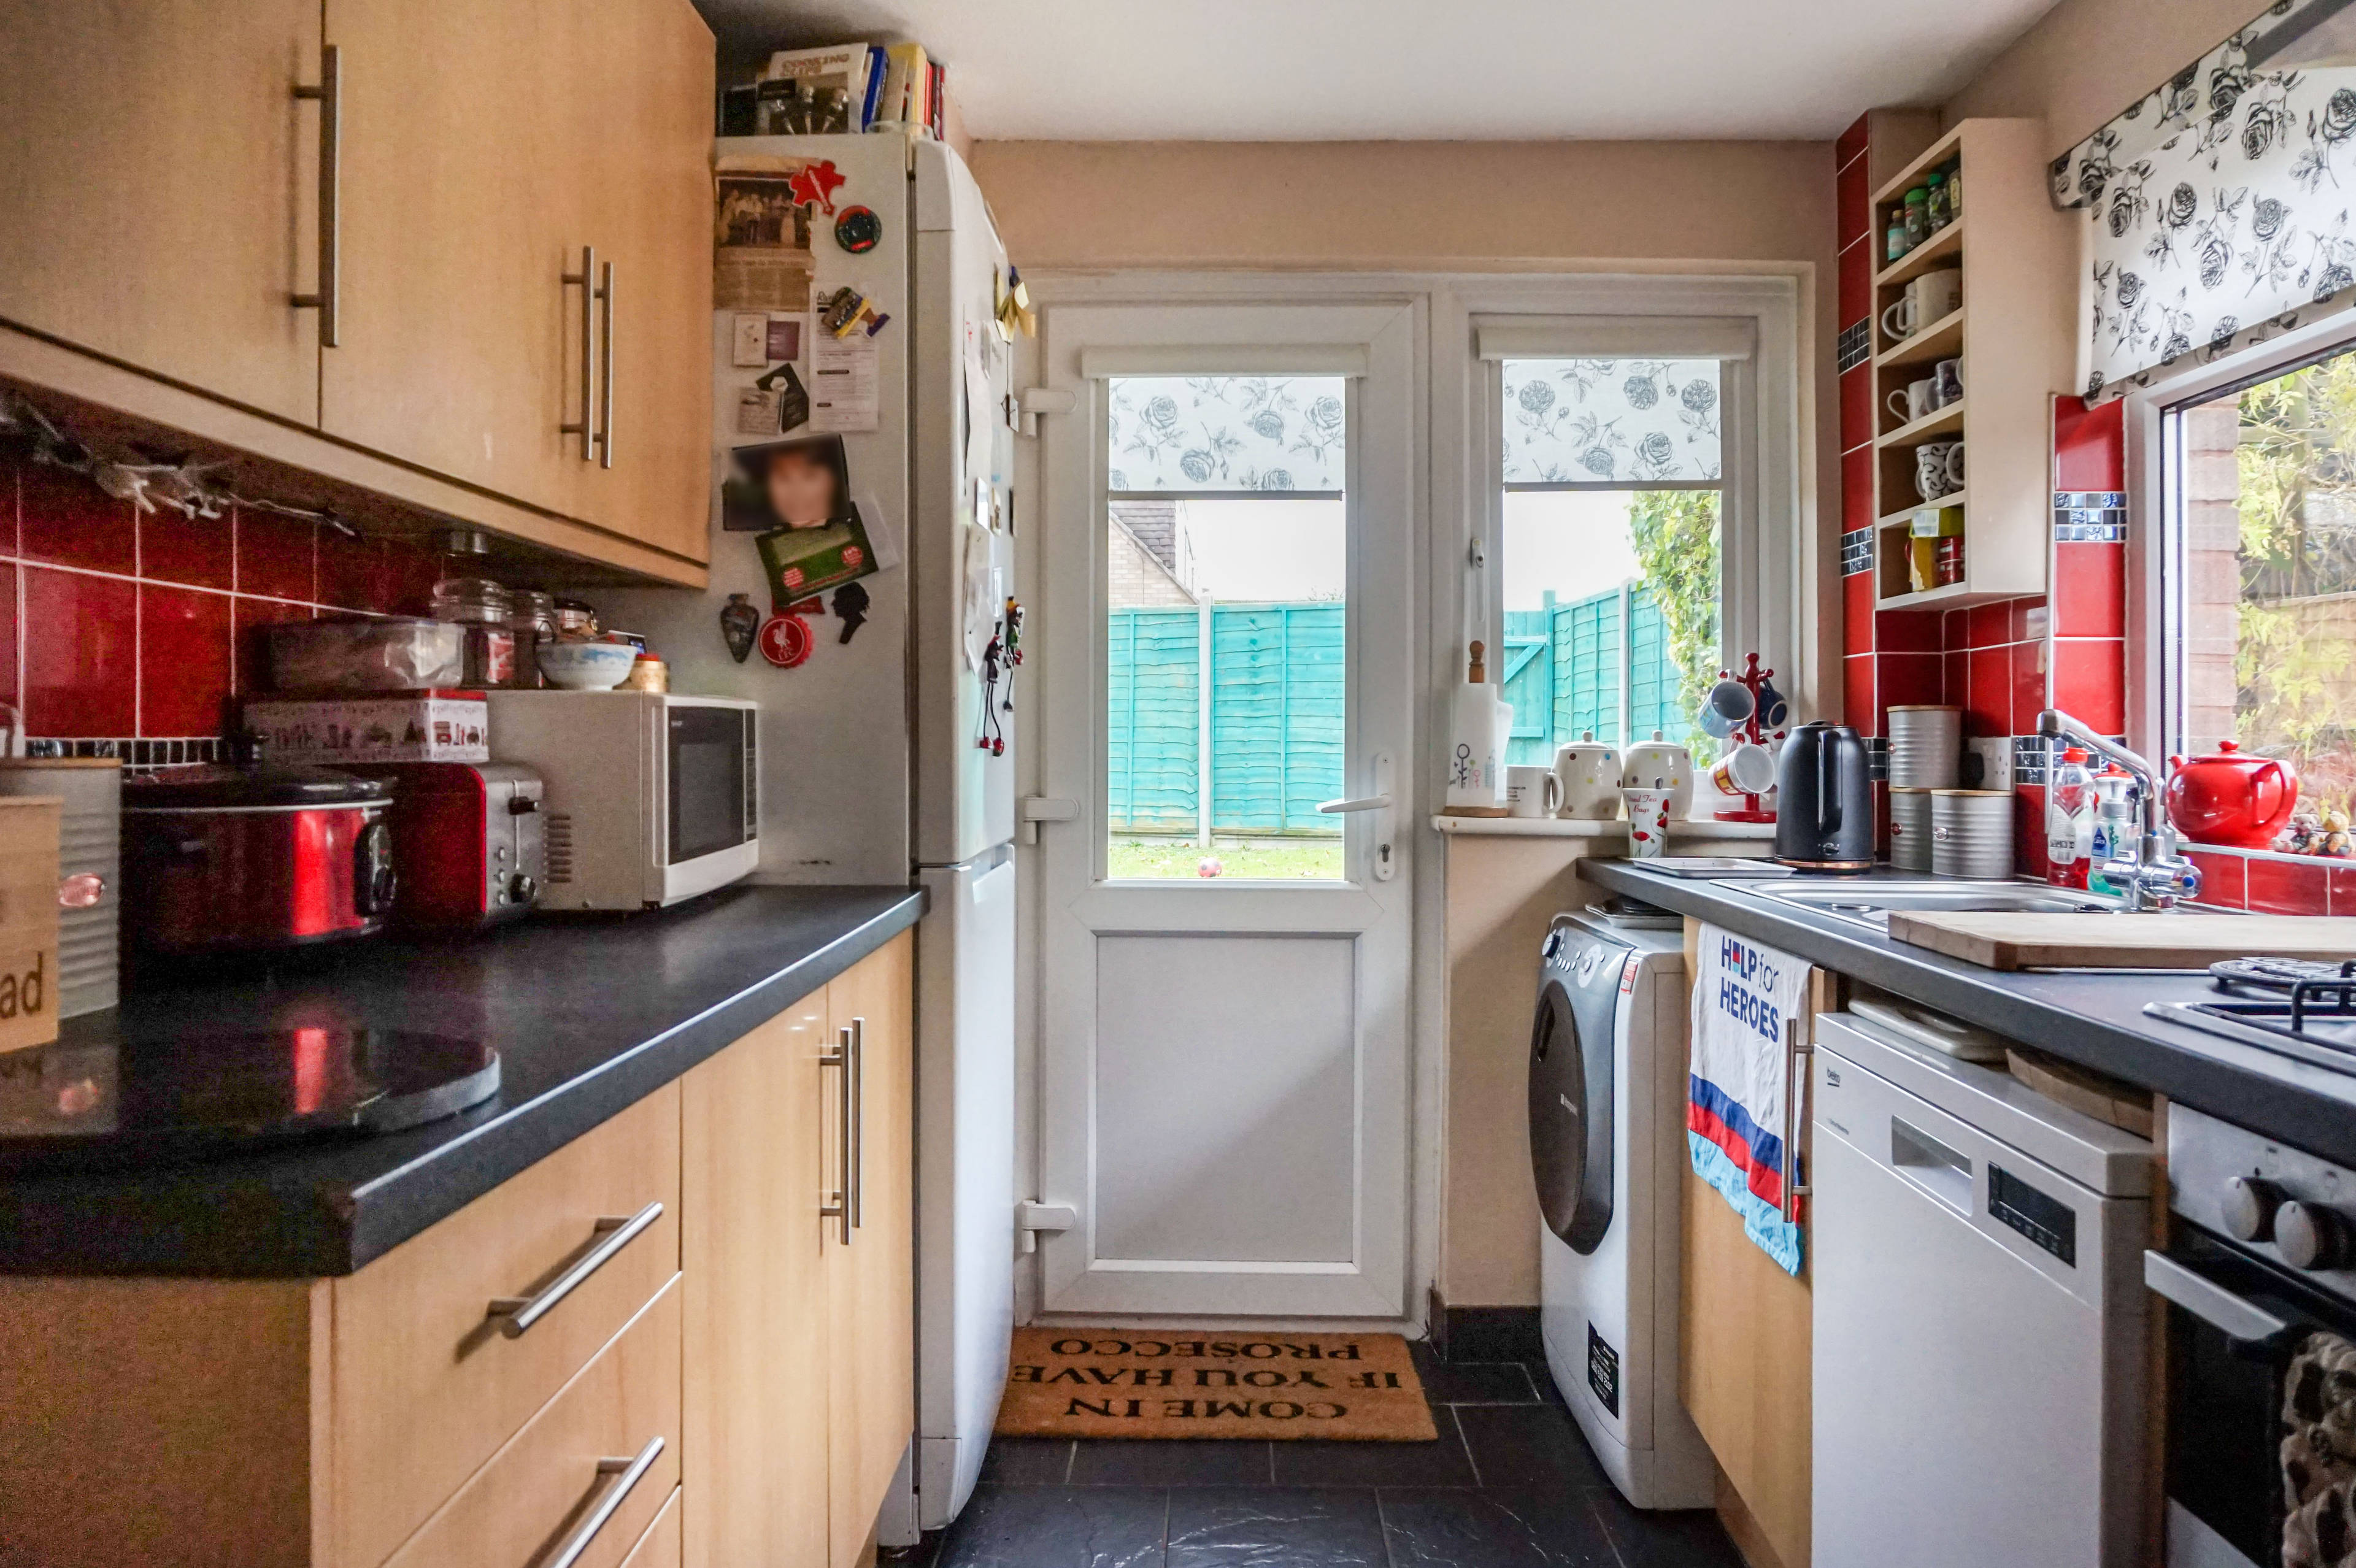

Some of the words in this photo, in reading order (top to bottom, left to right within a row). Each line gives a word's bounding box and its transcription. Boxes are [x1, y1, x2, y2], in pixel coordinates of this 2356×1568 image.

[1634, 804, 1650, 815] Bags
[1759, 954, 1779, 993] for
[1720, 977, 1779, 1043] HEROES
[1050, 1339, 1362, 1360] PROSECCO
[1012, 1365, 1173, 1386] HAVE
[1195, 1369, 1334, 1388] YOU
[1348, 1372, 1402, 1388] IF
[1064, 1397, 1142, 1417] IN
[1163, 1400, 1348, 1419] COME
